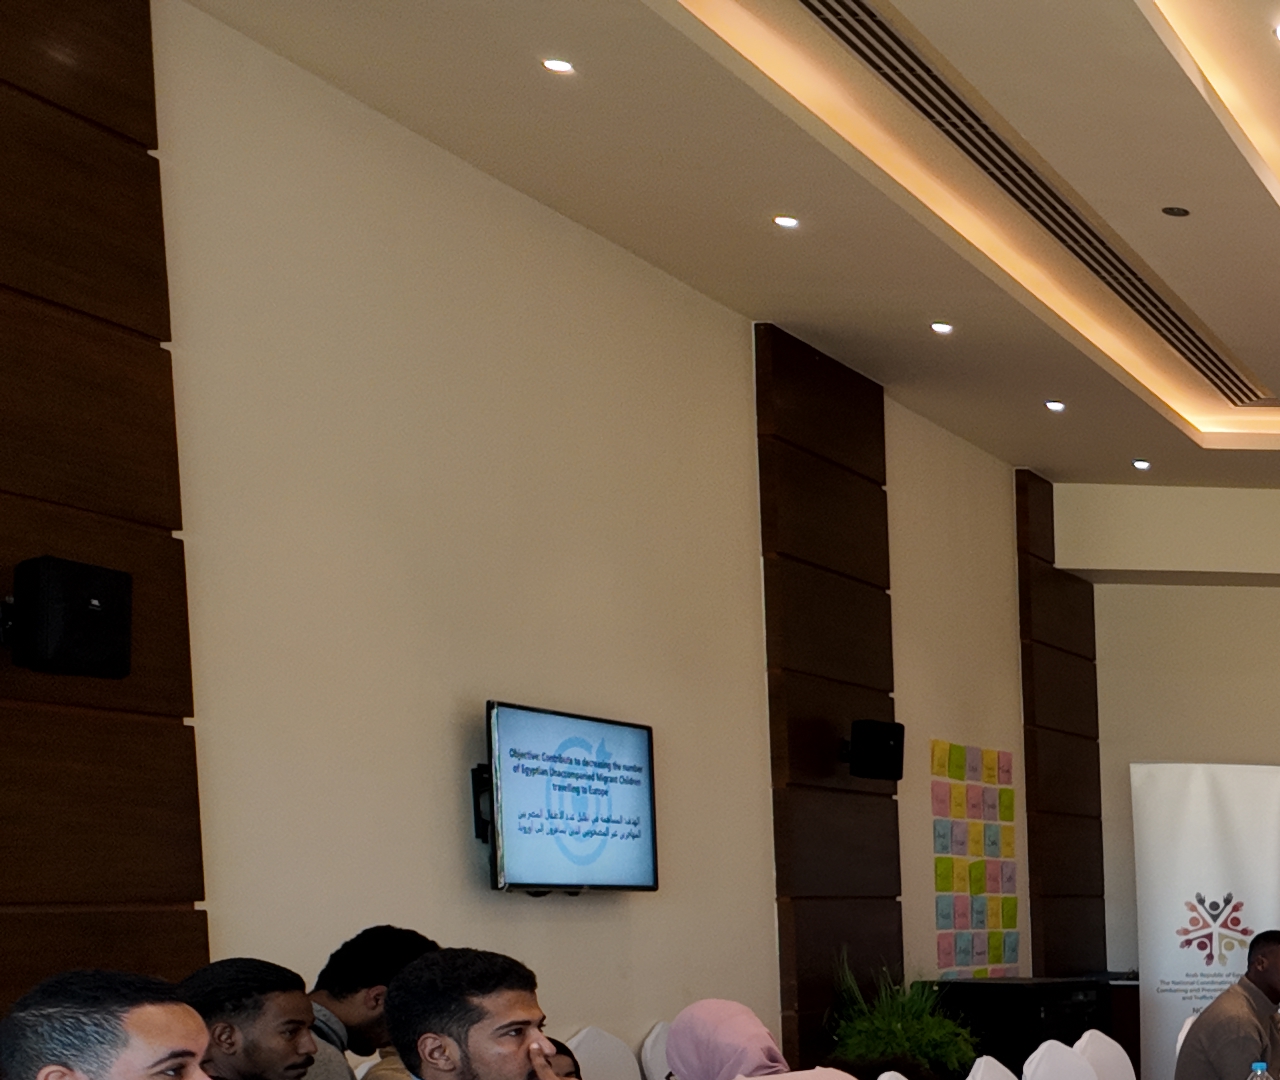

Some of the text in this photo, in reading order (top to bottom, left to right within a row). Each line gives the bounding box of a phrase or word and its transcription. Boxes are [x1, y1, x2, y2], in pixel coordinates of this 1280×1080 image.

[541, 751, 573, 766] Contribute
[573, 756, 581, 766] to
[582, 757, 612, 772] decreasing
[612, 761, 622, 771] the
[622, 763, 643, 773] number
[512, 763, 642, 787] of Egyptian Unaccompanied Migrant Children
[552, 783, 609, 798] travelling to Europe
[1200, 972, 1224, 980] Republic
